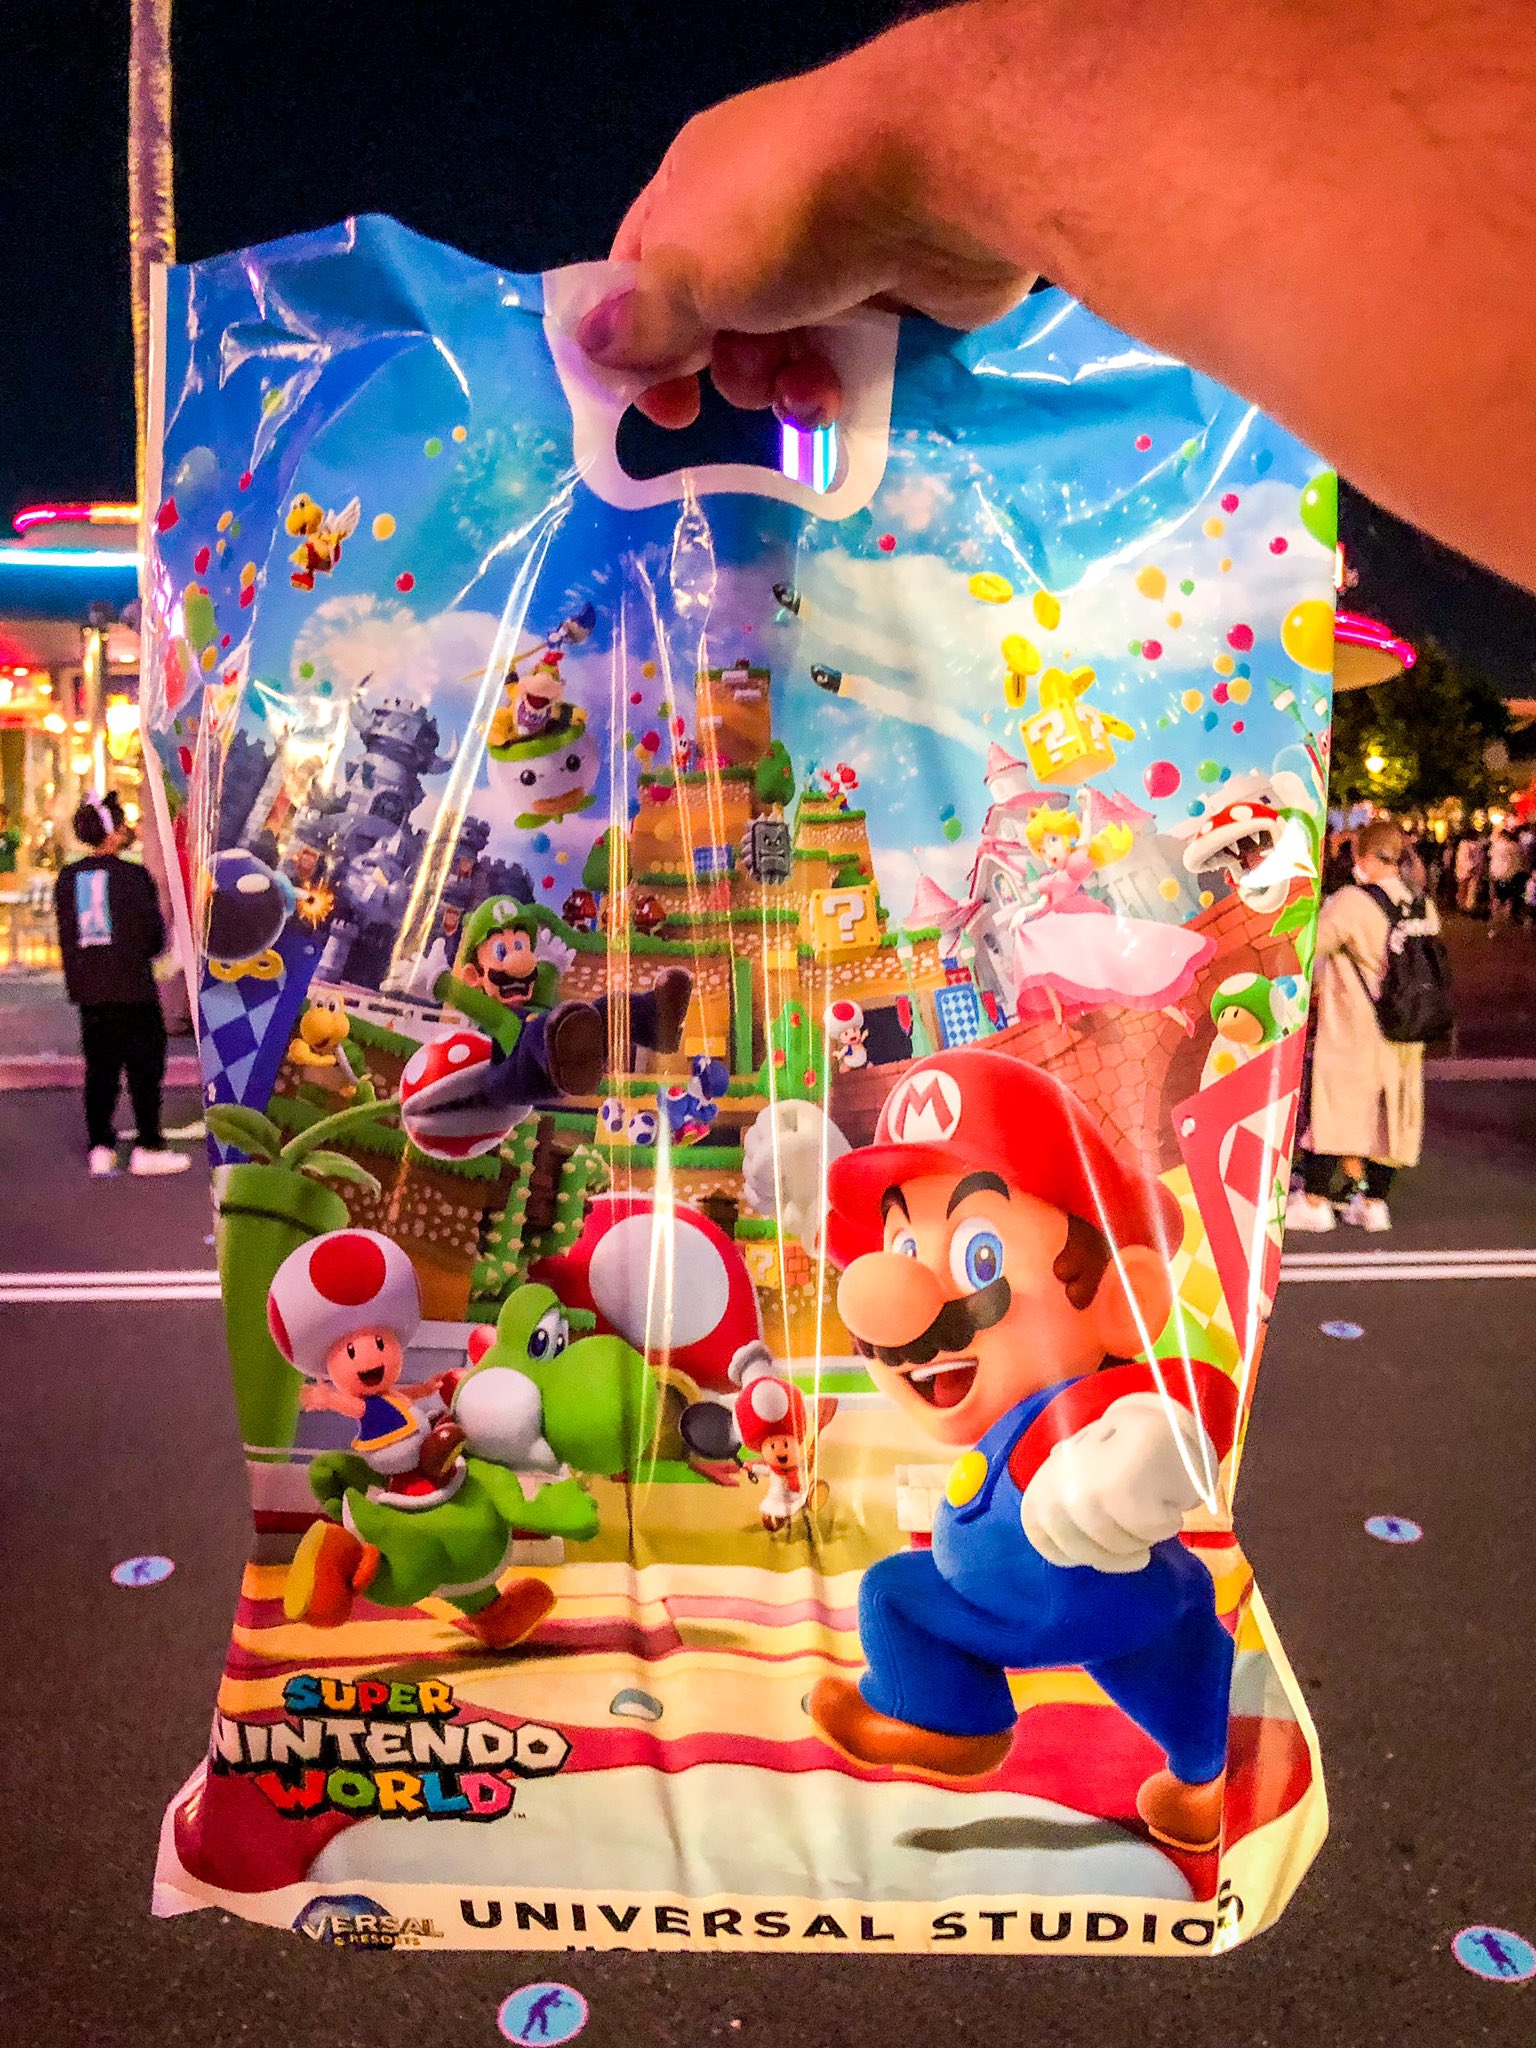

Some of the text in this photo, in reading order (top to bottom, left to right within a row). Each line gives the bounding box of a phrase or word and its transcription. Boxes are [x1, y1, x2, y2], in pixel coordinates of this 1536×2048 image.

[894, 1076, 954, 1140] M
[283, 1674, 459, 1719] SUPER
[212, 1716, 573, 1777] NINTENDO
[255, 1768, 515, 1822] WORLD
[460, 1900, 895, 1941] UNIVERSAL
